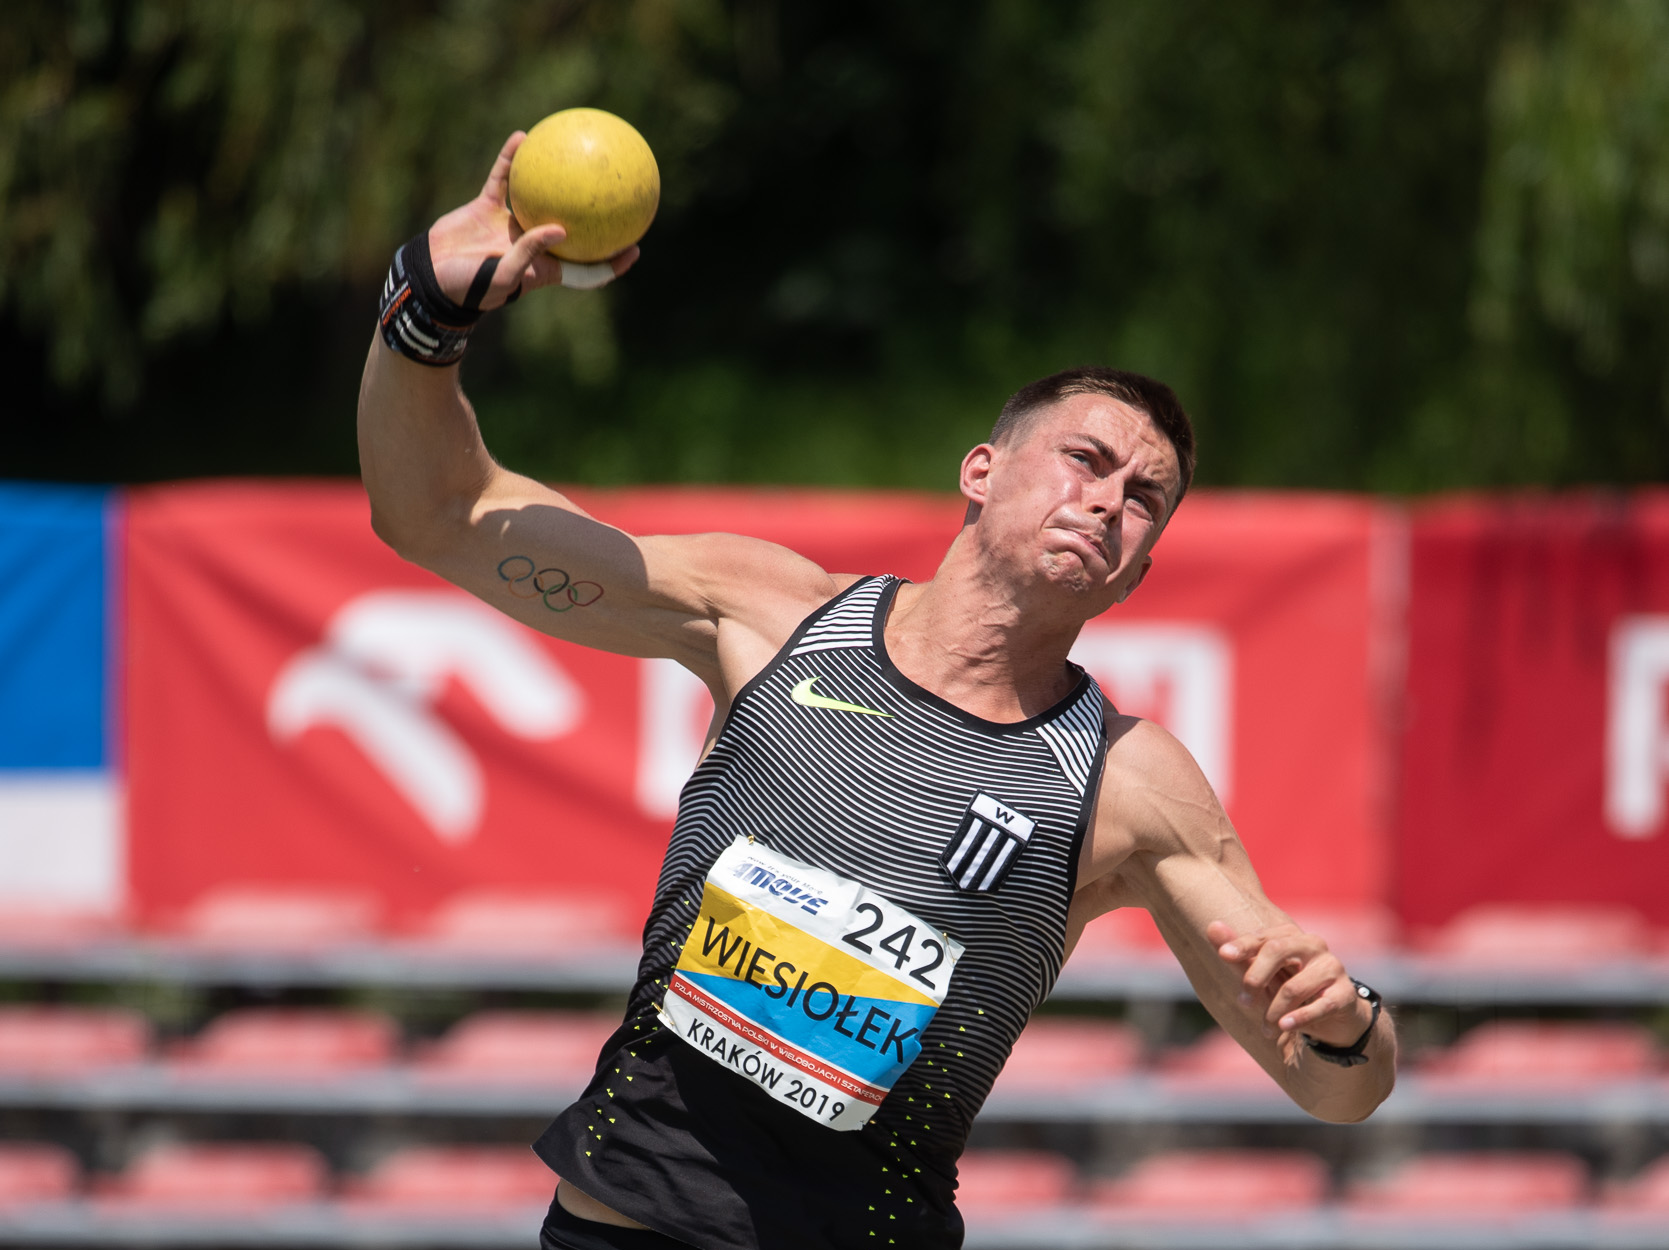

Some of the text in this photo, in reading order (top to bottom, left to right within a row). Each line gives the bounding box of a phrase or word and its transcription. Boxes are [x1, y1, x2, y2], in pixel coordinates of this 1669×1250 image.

[995, 806, 1015, 825] W
[701, 916, 920, 1064] WIESIOŁEK
[841, 902, 945, 991] 242
[674, 981, 693, 998] PZLA
[692, 995, 742, 1031] MISTRZOSTWA
[742, 1026, 769, 1045] POLSKI
[769, 1041, 779, 1051] W
[778, 1046, 838, 1082] WIELOBOJACH
[686, 1017, 846, 1122] KRAKÓW 2019
